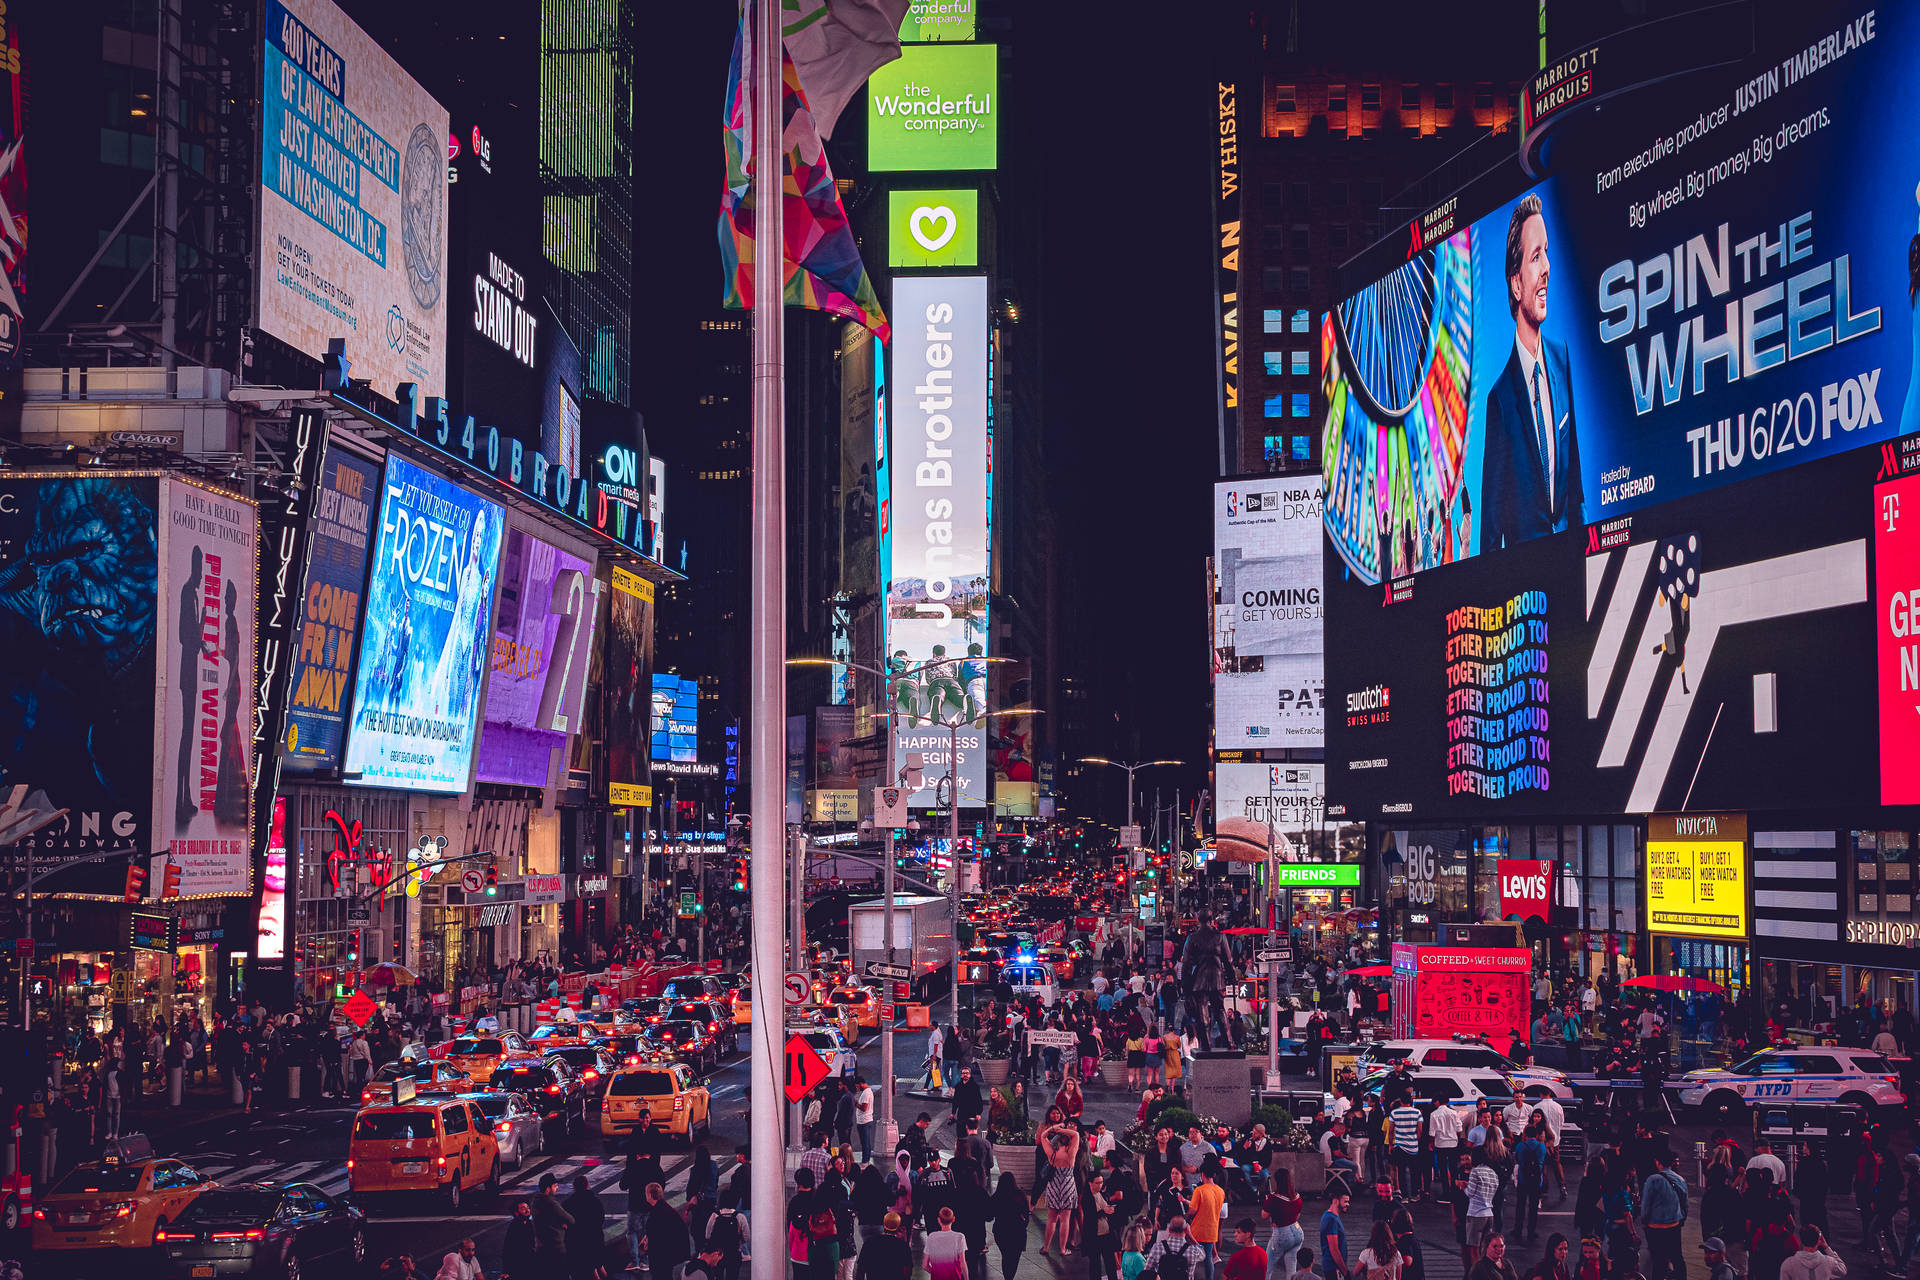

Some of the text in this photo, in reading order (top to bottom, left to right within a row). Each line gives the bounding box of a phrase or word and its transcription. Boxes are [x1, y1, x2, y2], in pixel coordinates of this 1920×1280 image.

[915, 15, 963, 26] company
[282, 13, 341, 97] 400 YEARS
[1535, 48, 1599, 95] MARRIOTT
[904, 82, 930, 97] the
[1536, 75, 1589, 118] MARQUIS
[1597, 10, 1875, 194] From executive producer JUSTIN TIMBERLAKE
[874, 93, 990, 117] Wonderful
[281, 59, 396, 187] OF LAW ENFORCEMENT
[281, 109, 356, 198] JUST ARRIVED
[1219, 81, 1238, 200] WHISKY
[1629, 106, 1831, 228] Big wheel. Big money. Big dreams.
[279, 153, 294, 198] IN
[294, 163, 367, 252] WASHINGTON,
[1424, 197, 1458, 227] MARRIOTT
[278, 233, 292, 249] NOW
[1424, 216, 1454, 244] MARQUIS
[278, 251, 355, 309] GET YOUR TICKETS TODAY
[489, 251, 525, 302] MADE TO
[1598, 210, 1813, 344] SPIN THE
[474, 274, 536, 369] STAND OUT
[1625, 253, 1882, 417] WHEEL
[1686, 367, 1883, 478] THU 6/20 FOX
[120, 433, 172, 444] LAMAR
[605, 445, 636, 487] ON
[915, 302, 953, 629] Jonas Brothers
[1601, 464, 1630, 485] Hosted by
[598, 482, 639, 502] smart media
[1284, 490, 1310, 502] NBA
[1601, 474, 1656, 506] DAX SHEPARD
[186, 494, 240, 525] HAVE A REALLY
[320, 488, 369, 533] BEST MUSICAL
[398, 481, 470, 531] LET YOURSELF GO
[173, 511, 250, 547] GOOD TIME TONIGHT
[1601, 517, 1633, 534] MARRIOTT
[1601, 532, 1629, 547] MARQUIS
[377, 484, 468, 600] FROZEN
[634, 581, 645, 594] POST
[1242, 587, 1320, 609] COMING
[1393, 577, 1415, 591] MARRIOTT
[1393, 589, 1412, 601] MARQUIS
[202, 553, 222, 667] PRETTY
[307, 581, 359, 631] COME
[1242, 607, 1312, 622] GET YOURS
[1446, 590, 1547, 635] TOGETHER PROUD
[300, 622, 353, 672] FROM
[1486, 622, 1525, 660] PROUD
[492, 638, 541, 680] FOREVER 21
[1446, 649, 1548, 689] TOGETHER PROUD
[293, 665, 348, 712] AWAY
[1347, 687, 1382, 712] swatch
[1486, 679, 1526, 715] PROUD
[378, 711, 433, 739] HOTTEST ON
[1347, 712, 1390, 727] SWISS MADE
[1447, 707, 1549, 743] TOGETHER PROUD
[200, 688, 219, 811] WOMAN
[1487, 736, 1526, 771] PROUD
[672, 764, 710, 773] David Muir
[1448, 765, 1549, 799] TOGETHER PROUD
[611, 789, 645, 800] ARNETTE POST
[1245, 796, 1307, 807] GET YOUR
[1246, 808, 1289, 823] JUNE
[1675, 817, 1718, 835] INVICTA
[1408, 845, 1435, 880] BIG
[1651, 852, 1675, 864] BUY GET
[1700, 852, 1726, 865] BUY GET
[1281, 870, 1337, 881] FRIENDS
[1651, 867, 1691, 880] MORE WATCHES
[1651, 882, 1663, 894] FREE
[1700, 868, 1737, 880] MORE WATCH
[1409, 882, 1435, 903] BOLD
[1701, 883, 1713, 896] FREE
[480, 904, 507, 927] FOREVER
[195, 931, 211, 940] SONY
[872, 965, 906, 977] ONE WAY
[1422, 955, 1527, 966] COFFEED SWEET CHURROS
[1447, 1010, 1471, 1022] COFFEE
[1754, 1083, 1792, 1096] NYPD
